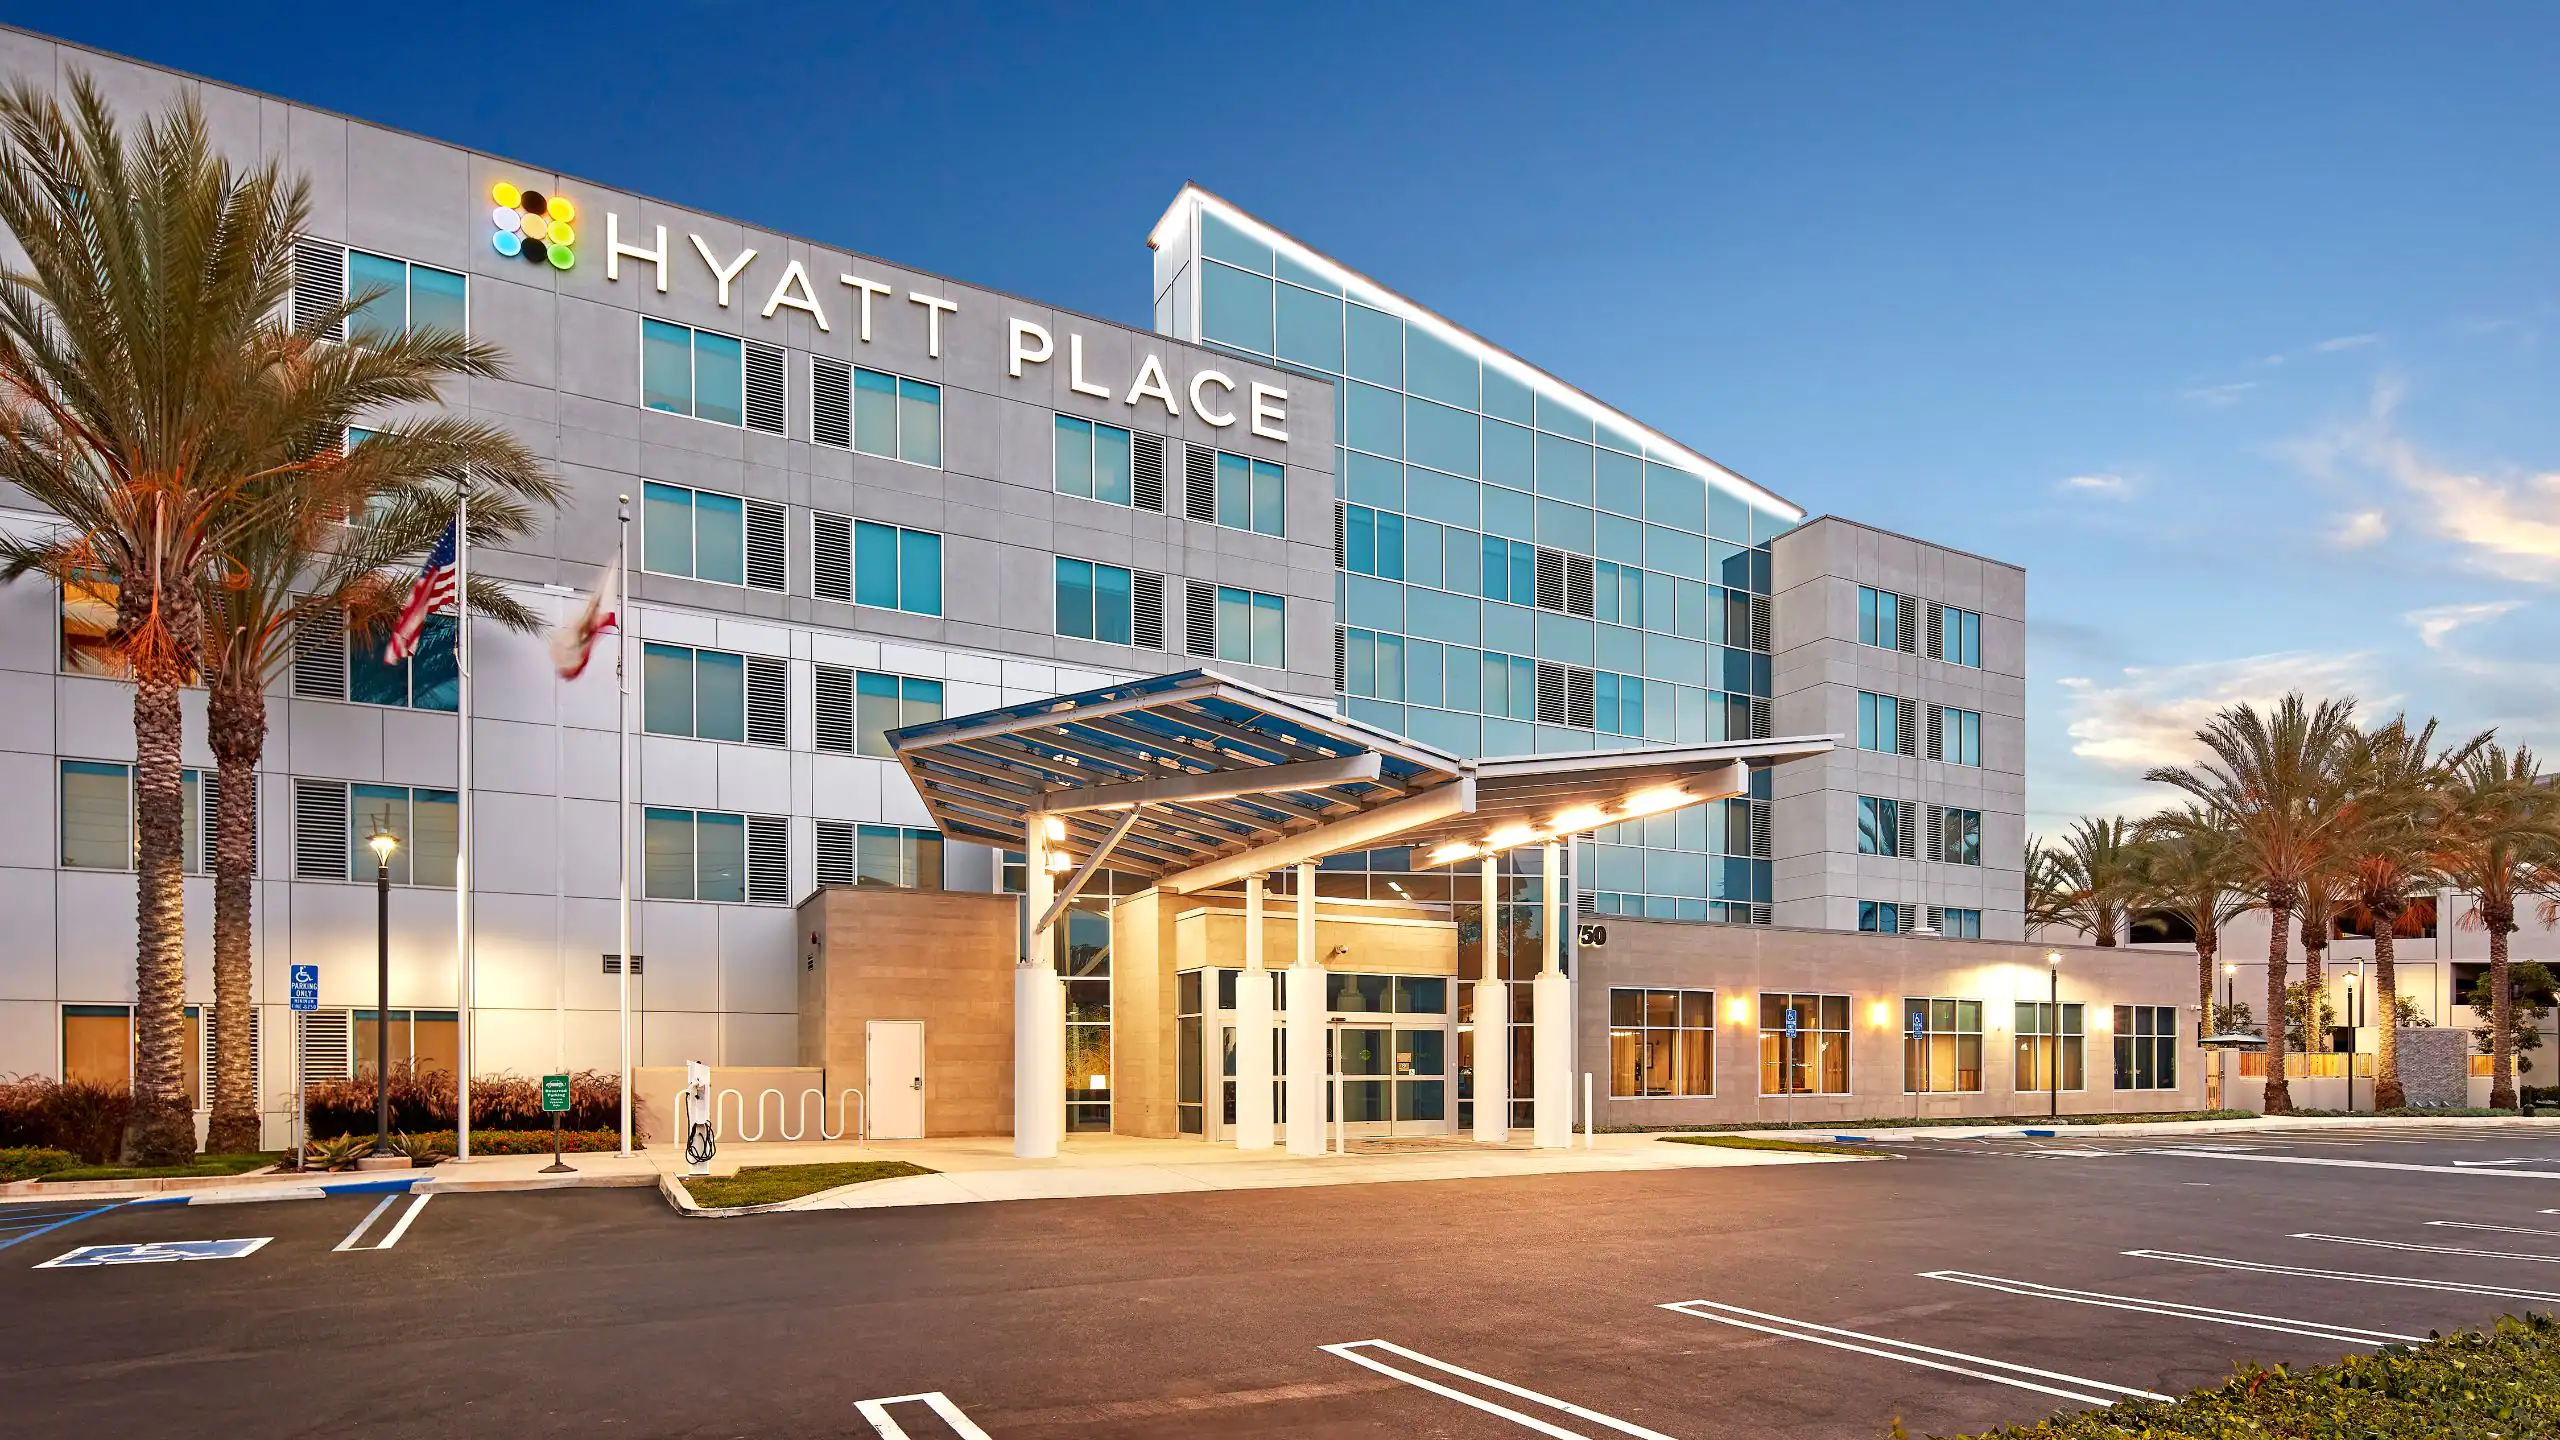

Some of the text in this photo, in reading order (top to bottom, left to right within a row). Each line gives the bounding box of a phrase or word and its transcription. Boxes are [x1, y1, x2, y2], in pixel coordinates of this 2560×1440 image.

[606, 211, 1289, 443] HYATT PLACE
[291, 982, 318, 990] PARKING
[295, 989, 313, 997] ONLY
